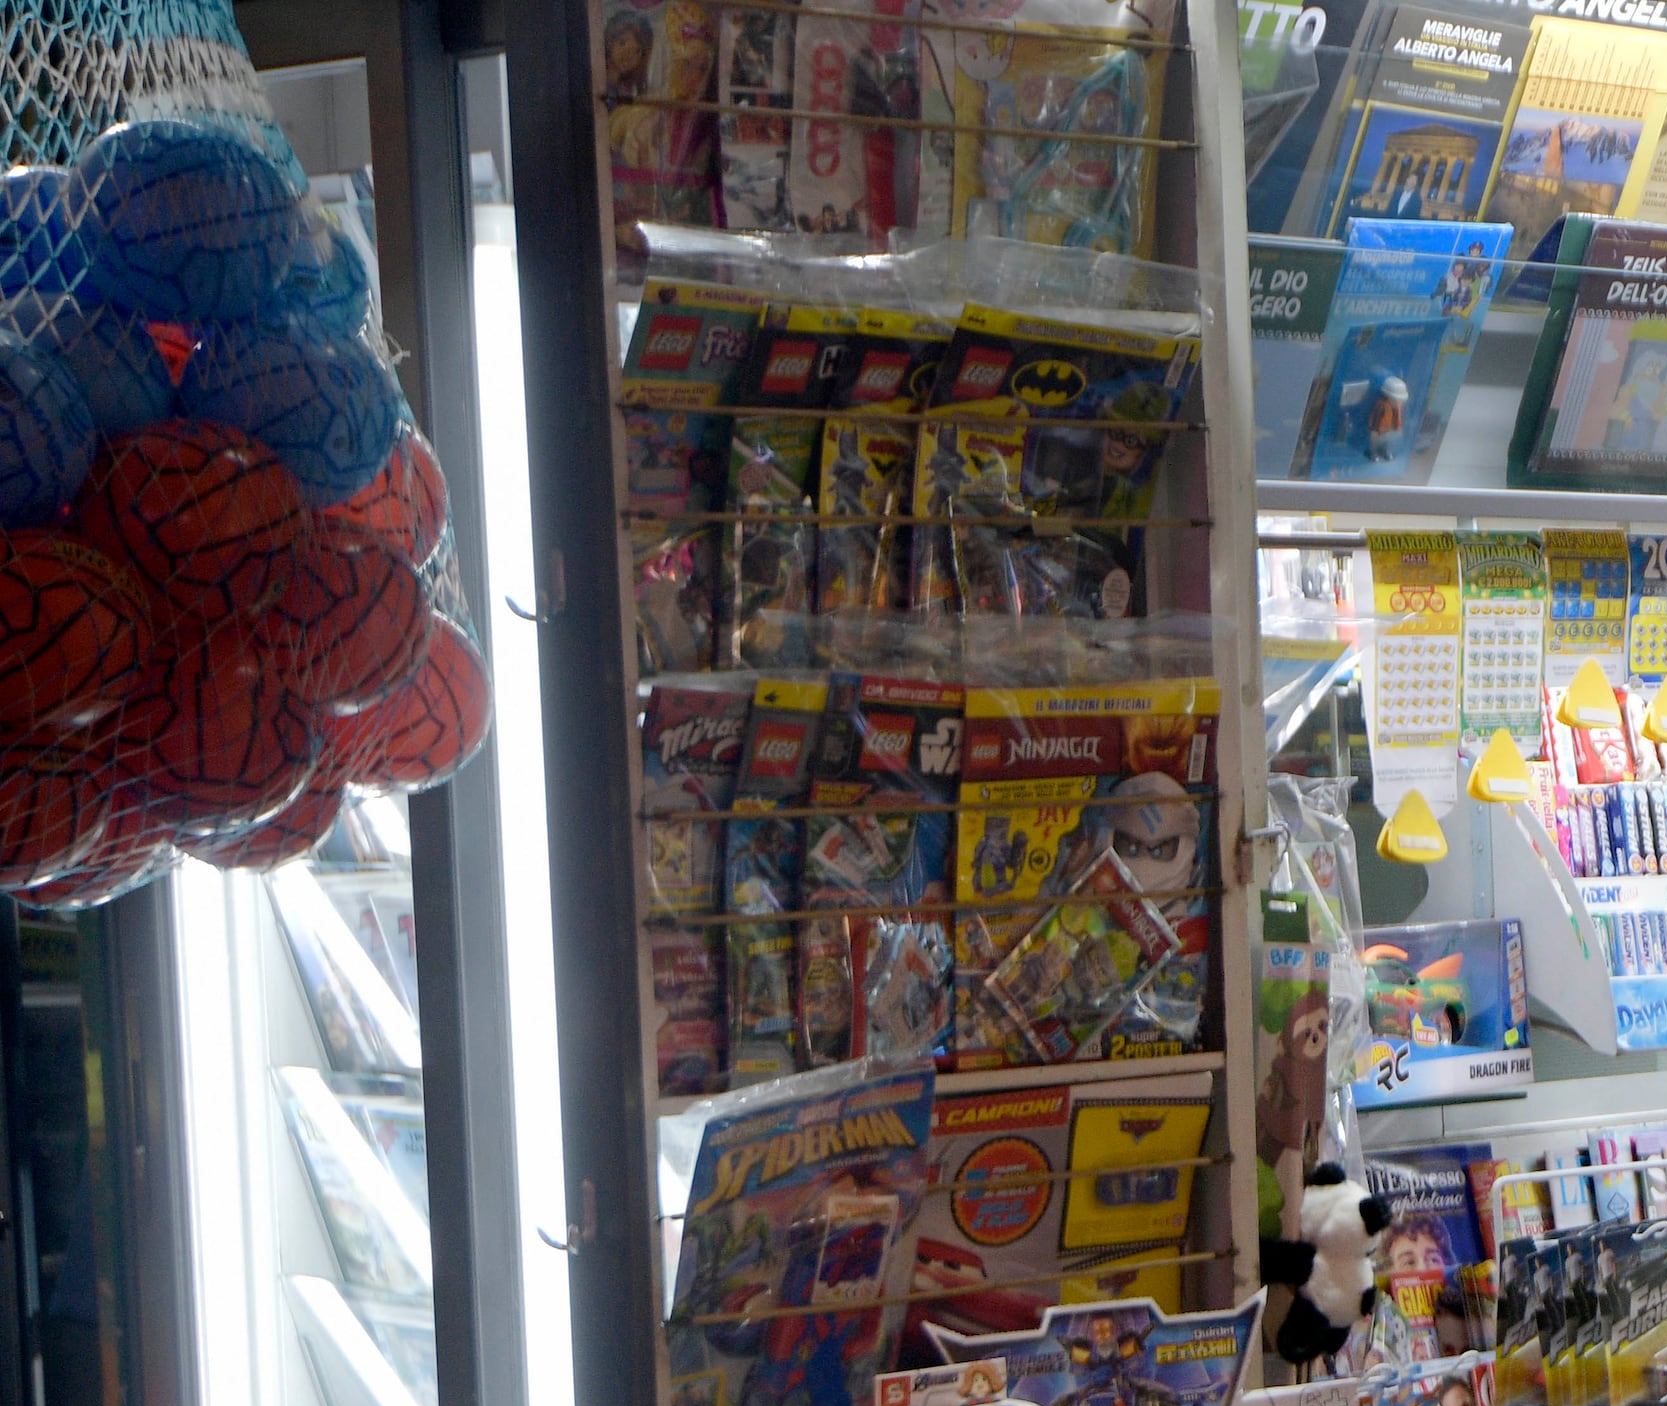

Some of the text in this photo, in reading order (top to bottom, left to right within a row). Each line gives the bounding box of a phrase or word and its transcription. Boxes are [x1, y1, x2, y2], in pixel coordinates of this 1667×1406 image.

[1423, 19, 1502, 46] MERAVIGLIE
[1395, 37, 1456, 62] ALBERTO
[1457, 46, 1513, 72] ANGELA
[1272, 269, 1309, 294] DIO
[649, 330, 692, 353] LEGO
[768, 355, 809, 380] LEGO
[860, 364, 903, 388] LEGO
[963, 357, 1006, 386] LEGO
[1485, 566, 1523, 576] MEGA
[758, 740, 798, 759] LEGO
[866, 728, 907, 751] LEGO
[1006, 736, 1103, 766] NINJAGO
[1034, 805, 1072, 827] JAY
[1269, 948, 1304, 968] BFF
[1109, 1033, 1124, 1058] 2
[1376, 1042, 1411, 1092] RC
[1469, 1057, 1531, 1079] DRAGON FIRE
[702, 1109, 919, 1207] SPIDER-MAN
